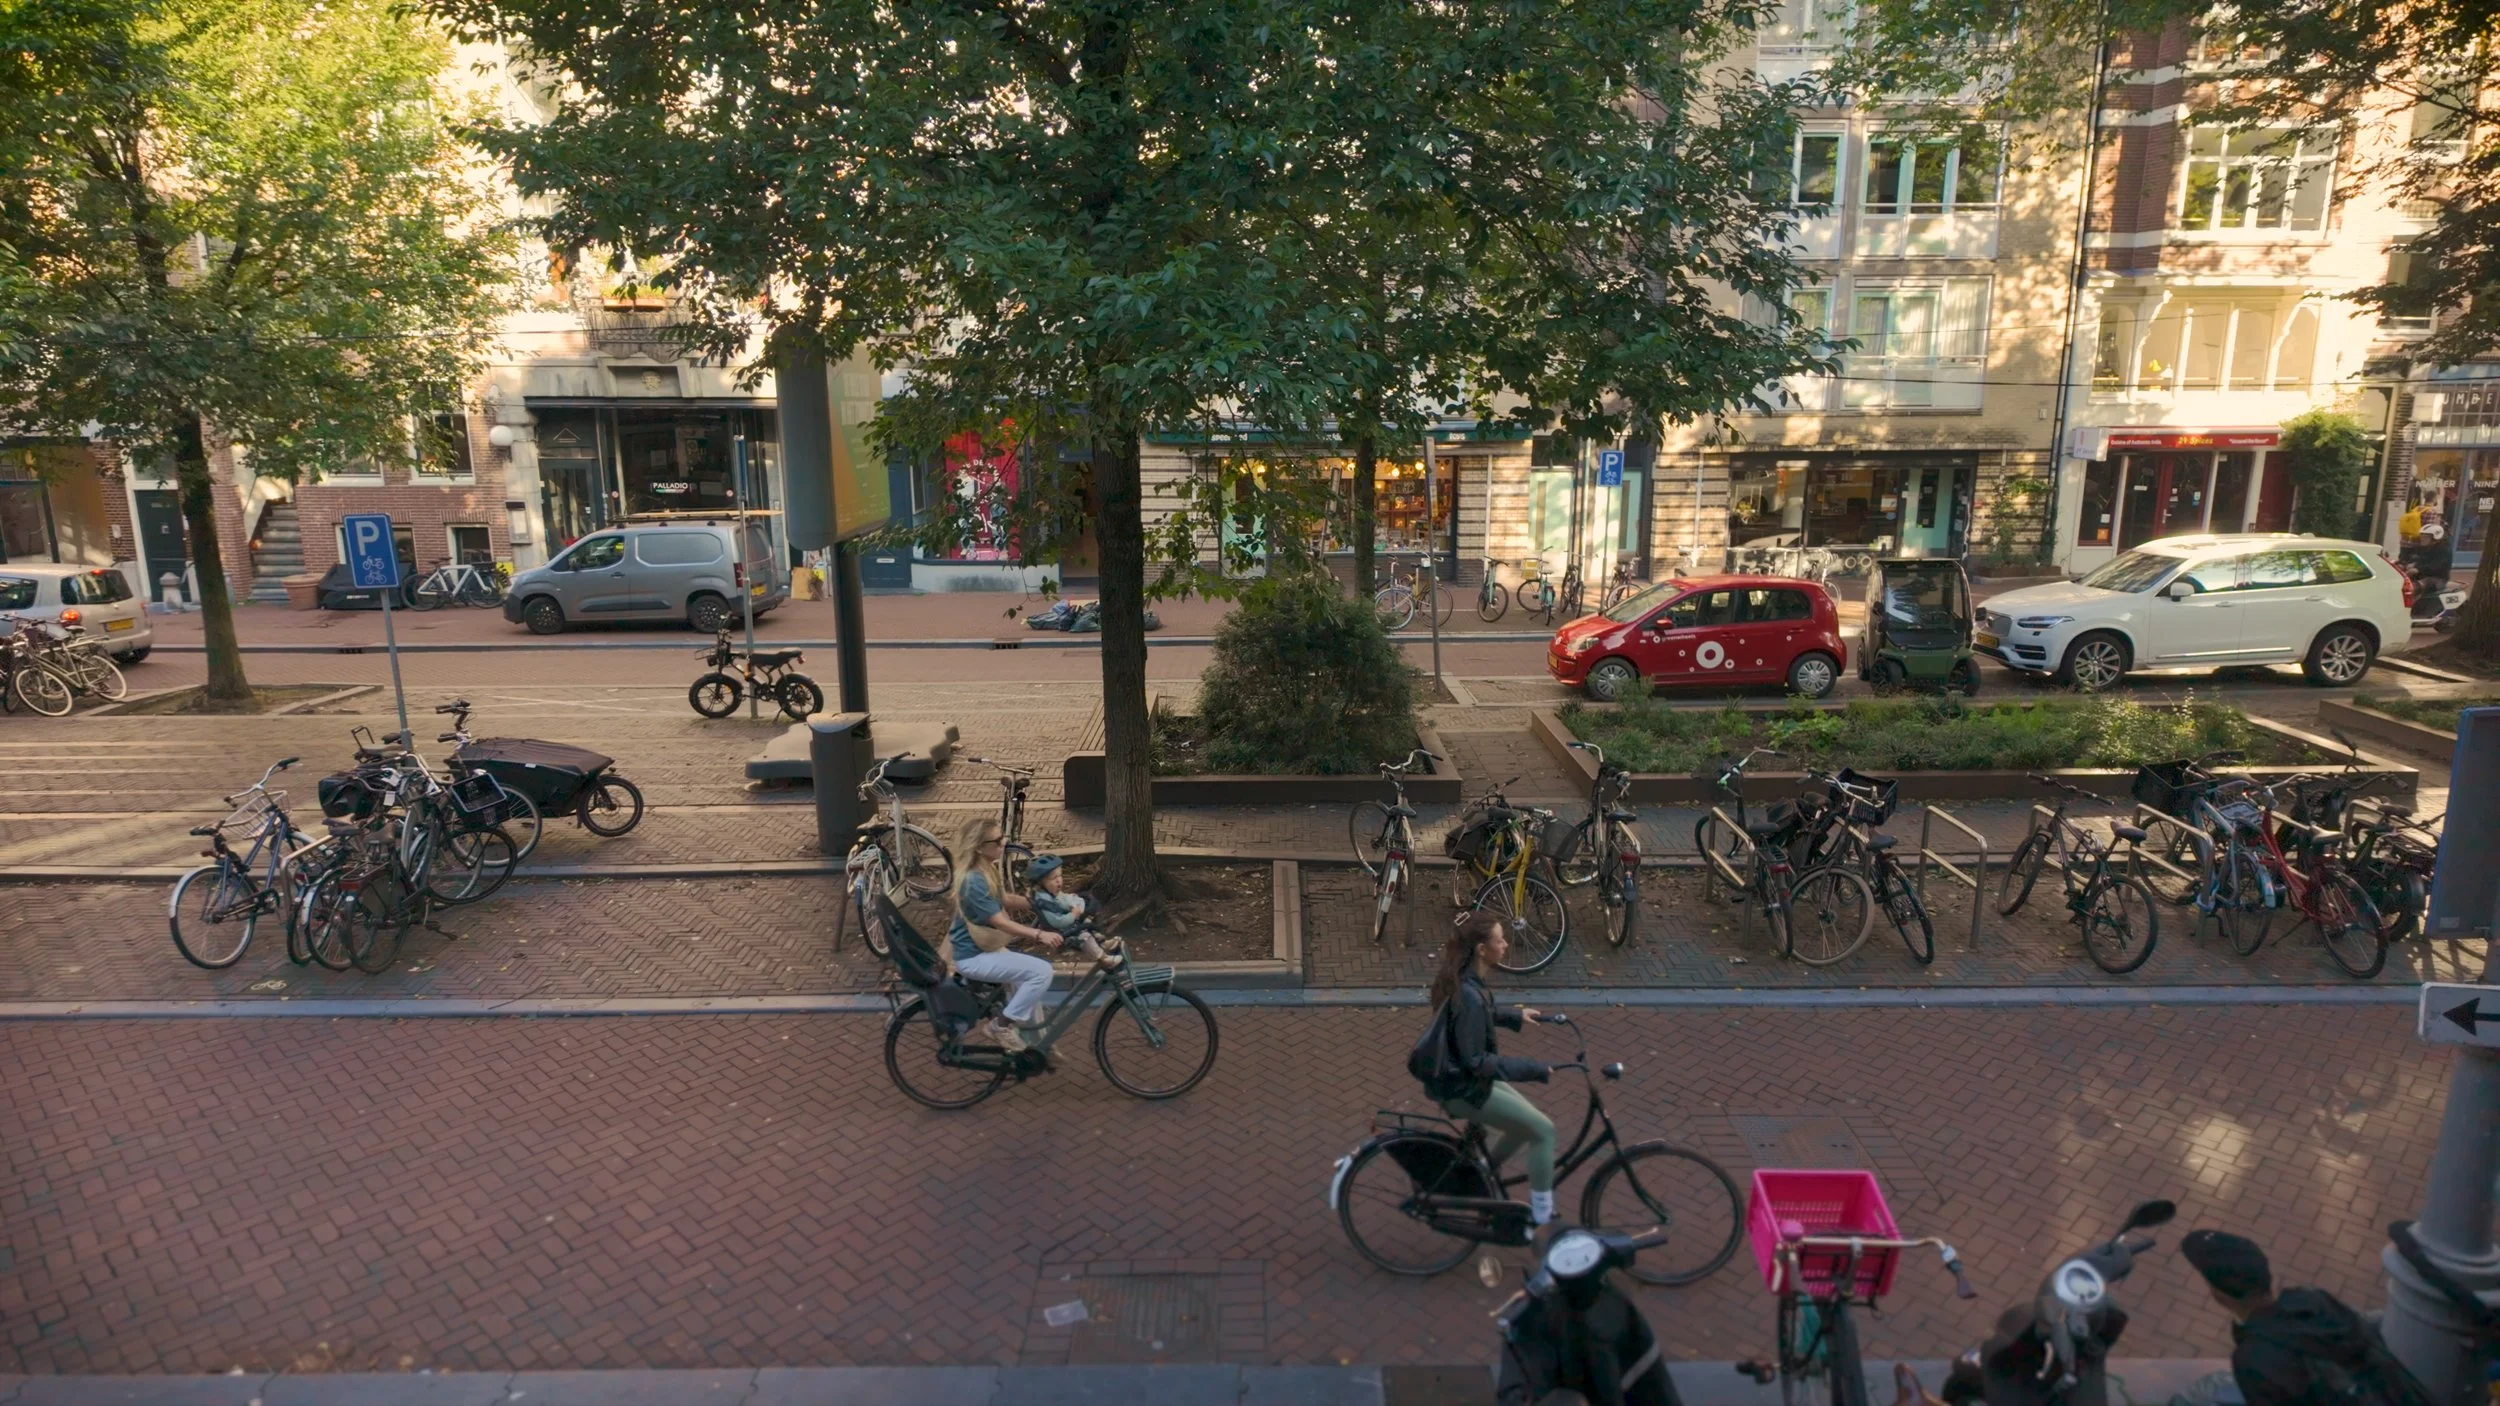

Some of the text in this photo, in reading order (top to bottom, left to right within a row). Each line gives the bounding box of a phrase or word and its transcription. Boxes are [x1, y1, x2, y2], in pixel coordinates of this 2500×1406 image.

[2442, 392, 2493, 405] UMBE
[1605, 454, 1619, 471] P
[355, 520, 380, 556] P
